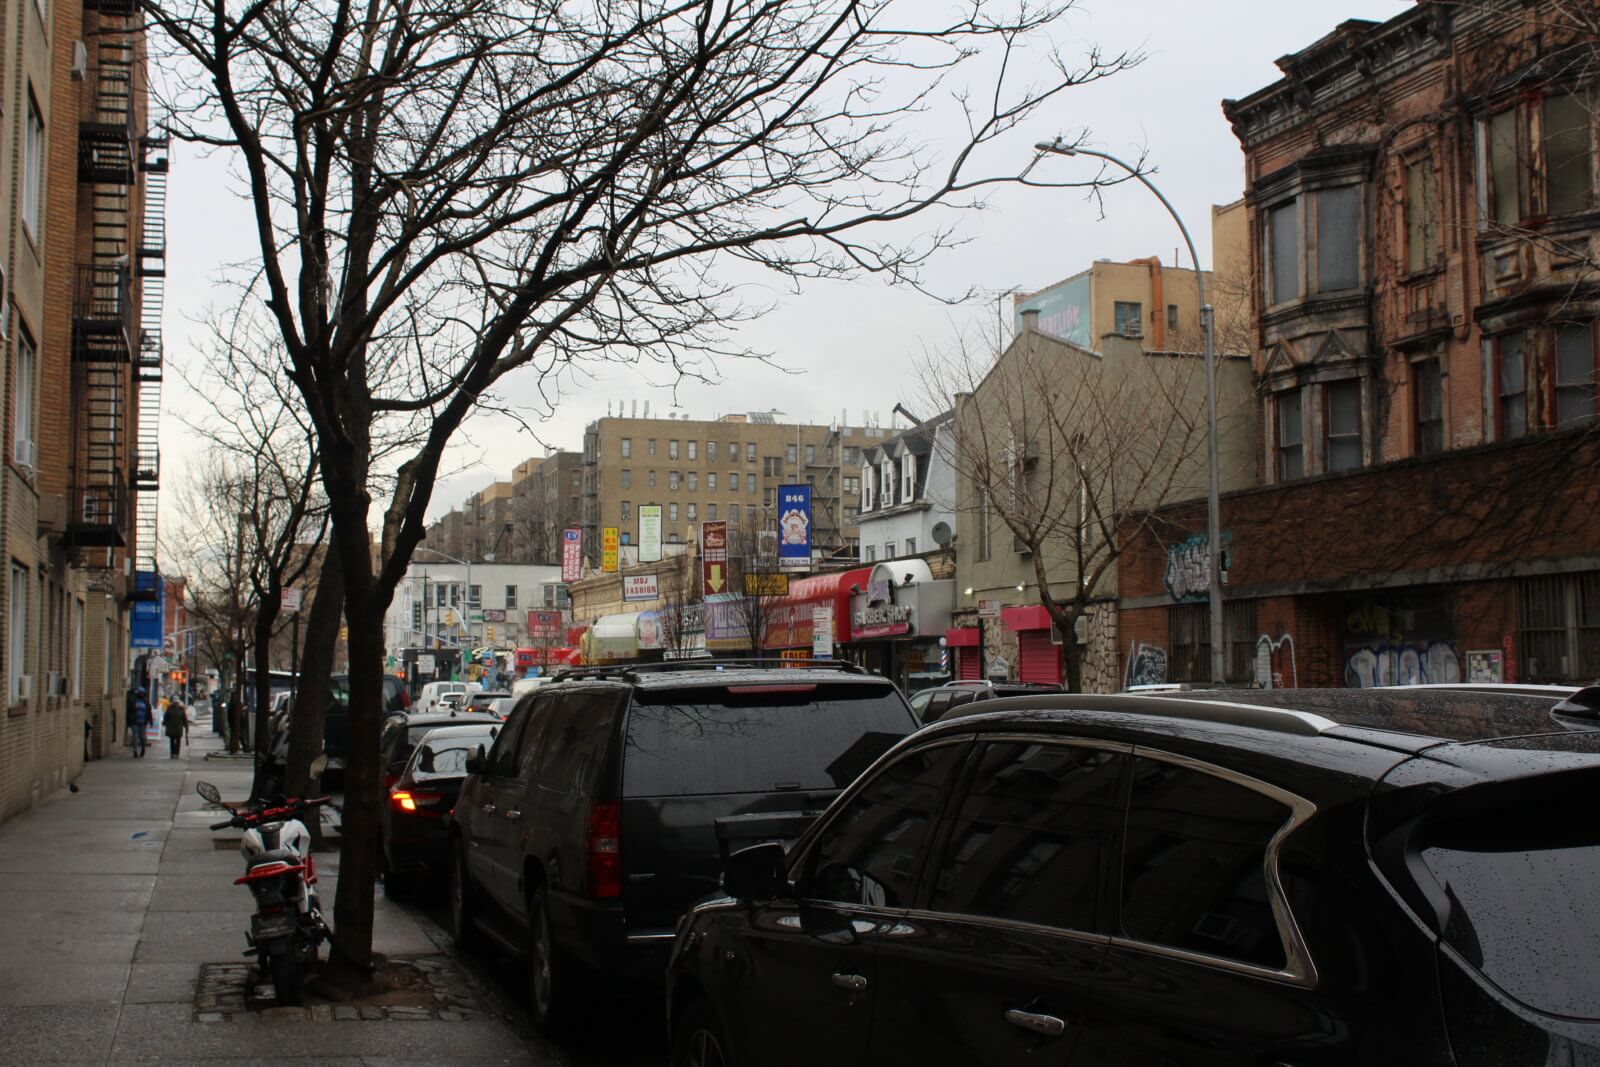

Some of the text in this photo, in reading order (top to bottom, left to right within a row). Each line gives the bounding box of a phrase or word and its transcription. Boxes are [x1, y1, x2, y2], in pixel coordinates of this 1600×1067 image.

[785, 494, 805, 502] 846
[568, 544, 576, 580] CHICKEN
[626, 585, 656, 595] FASHION
[854, 607, 886, 624] BARBER
[886, 604, 908, 622] SHOP
